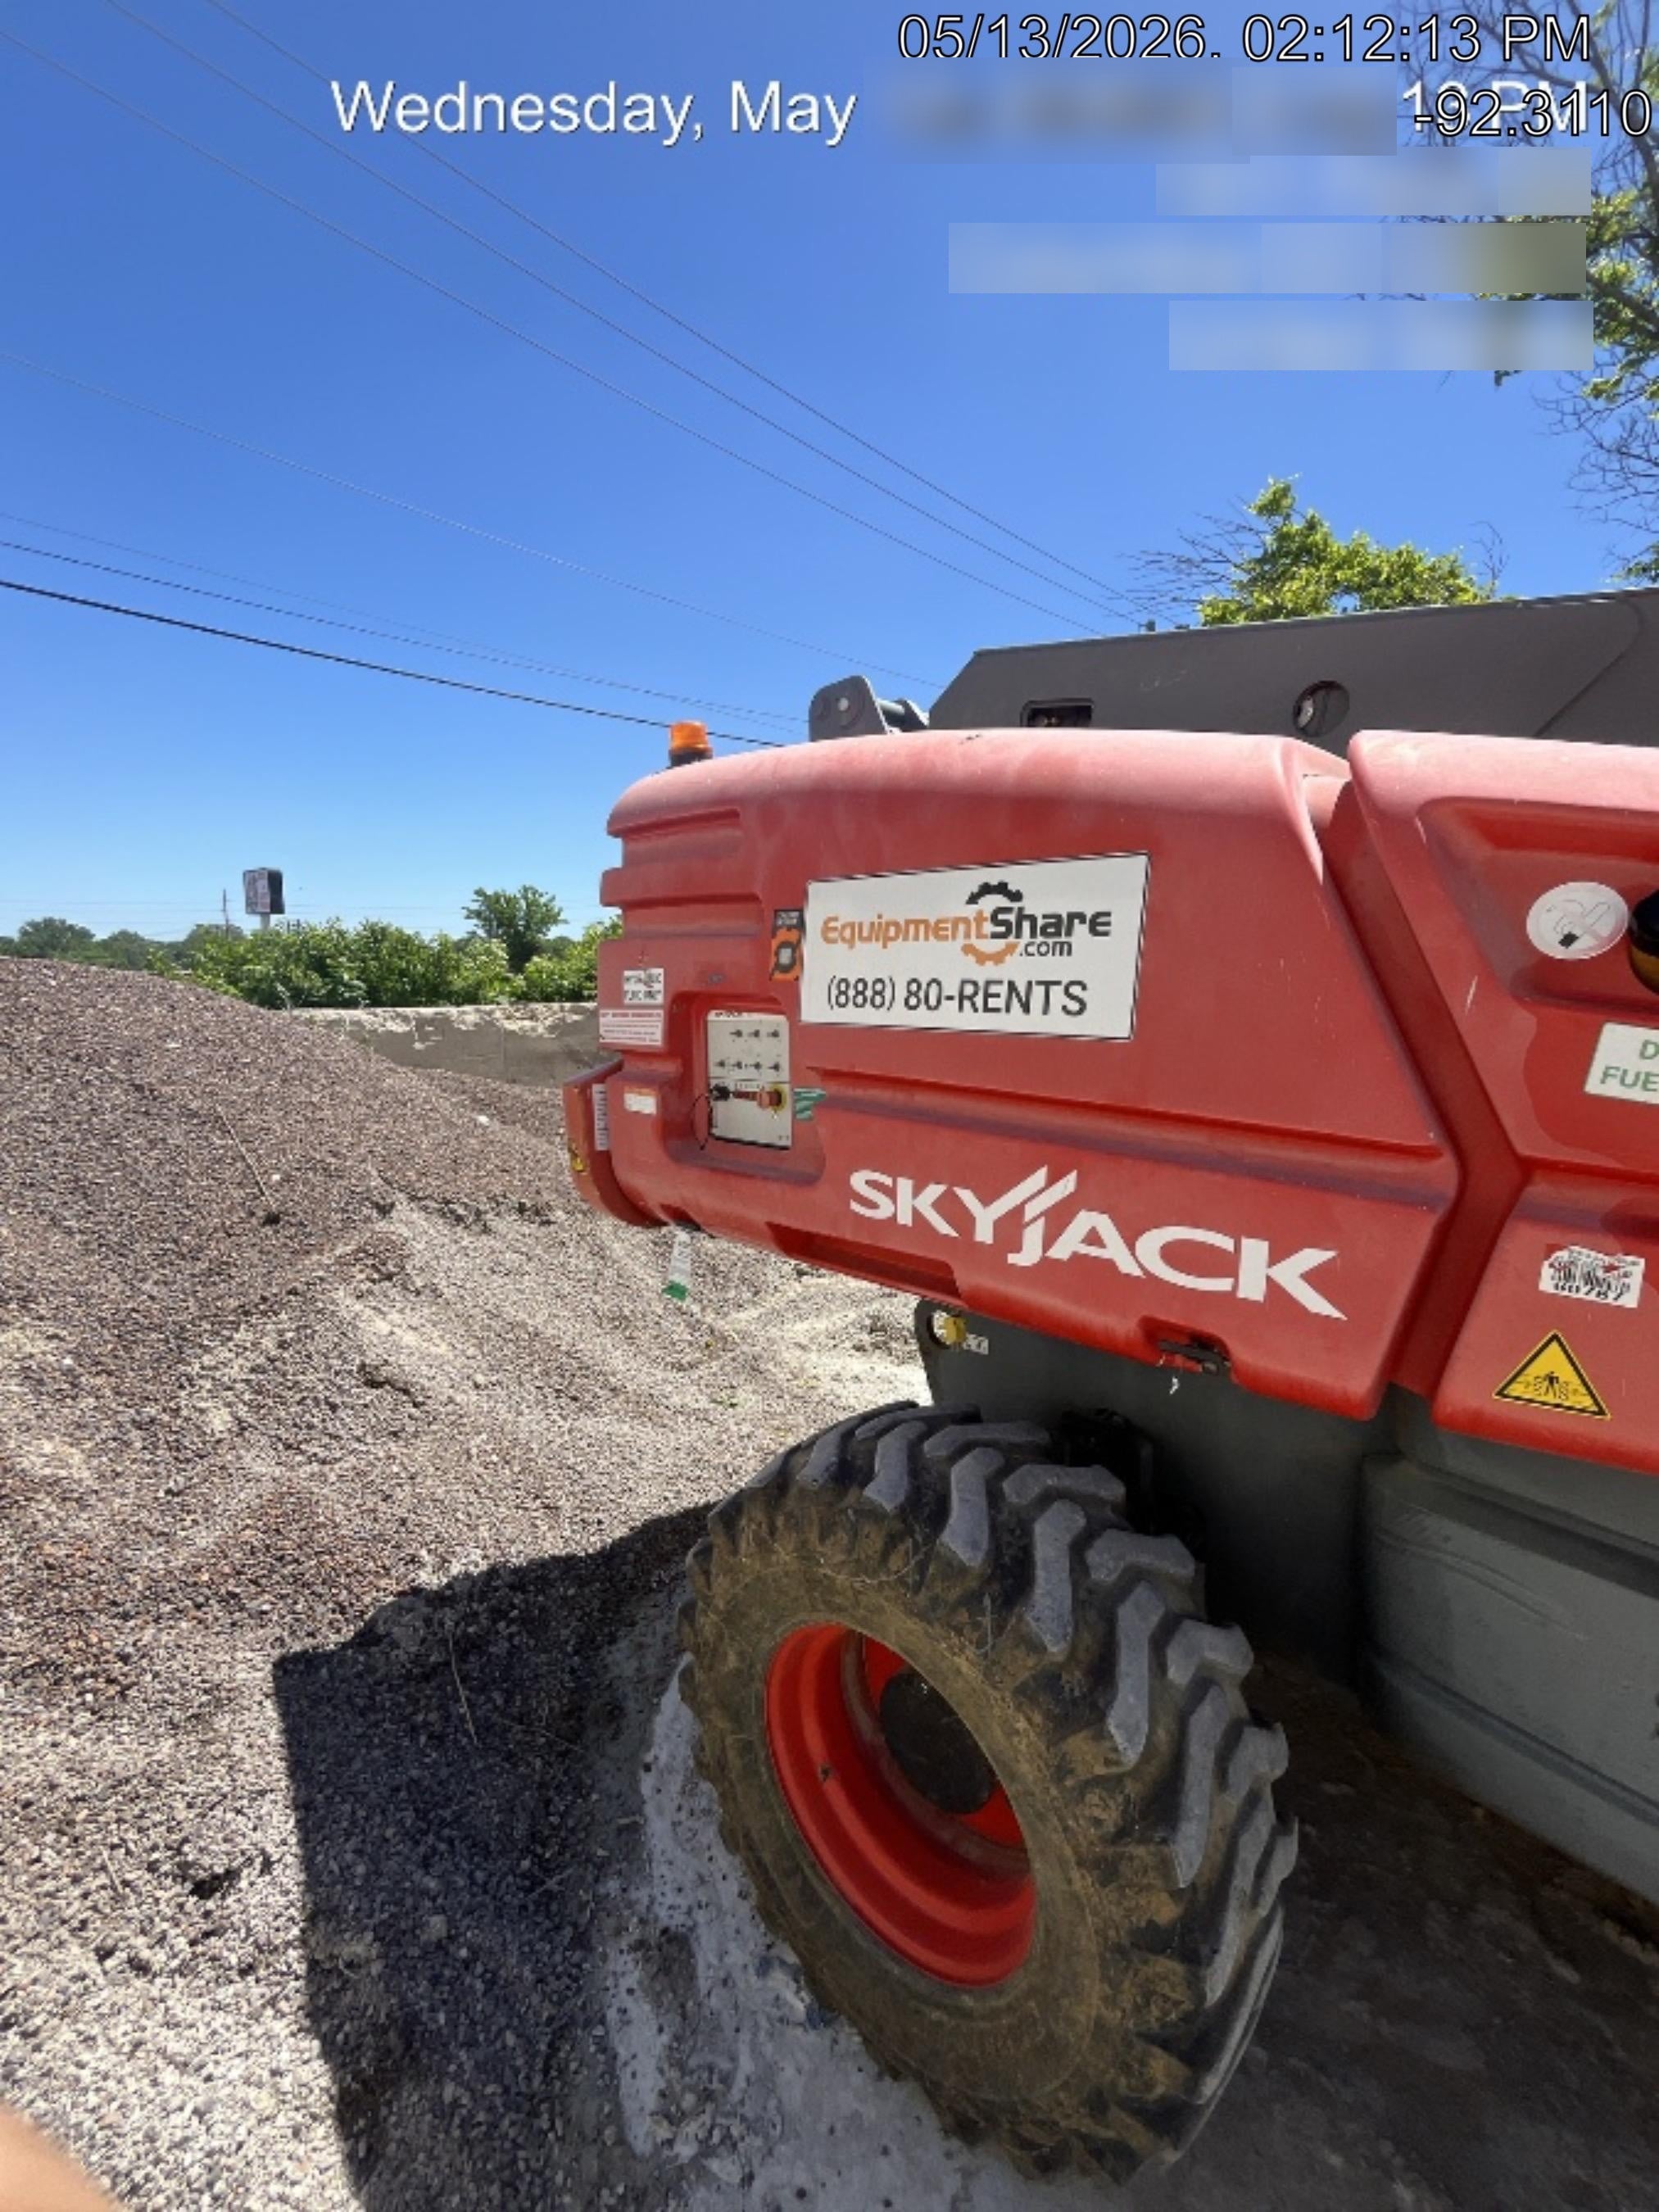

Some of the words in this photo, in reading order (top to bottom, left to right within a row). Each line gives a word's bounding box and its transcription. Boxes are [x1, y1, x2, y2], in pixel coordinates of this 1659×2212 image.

[821, 907, 1112, 949] EquipmentShare
[1019, 941, 1073, 957] .com
[827, 976, 896, 1010] (888)
[904, 977, 1088, 1017] 80-RENTS
[849, 1164, 1348, 1321] SKYJACK
